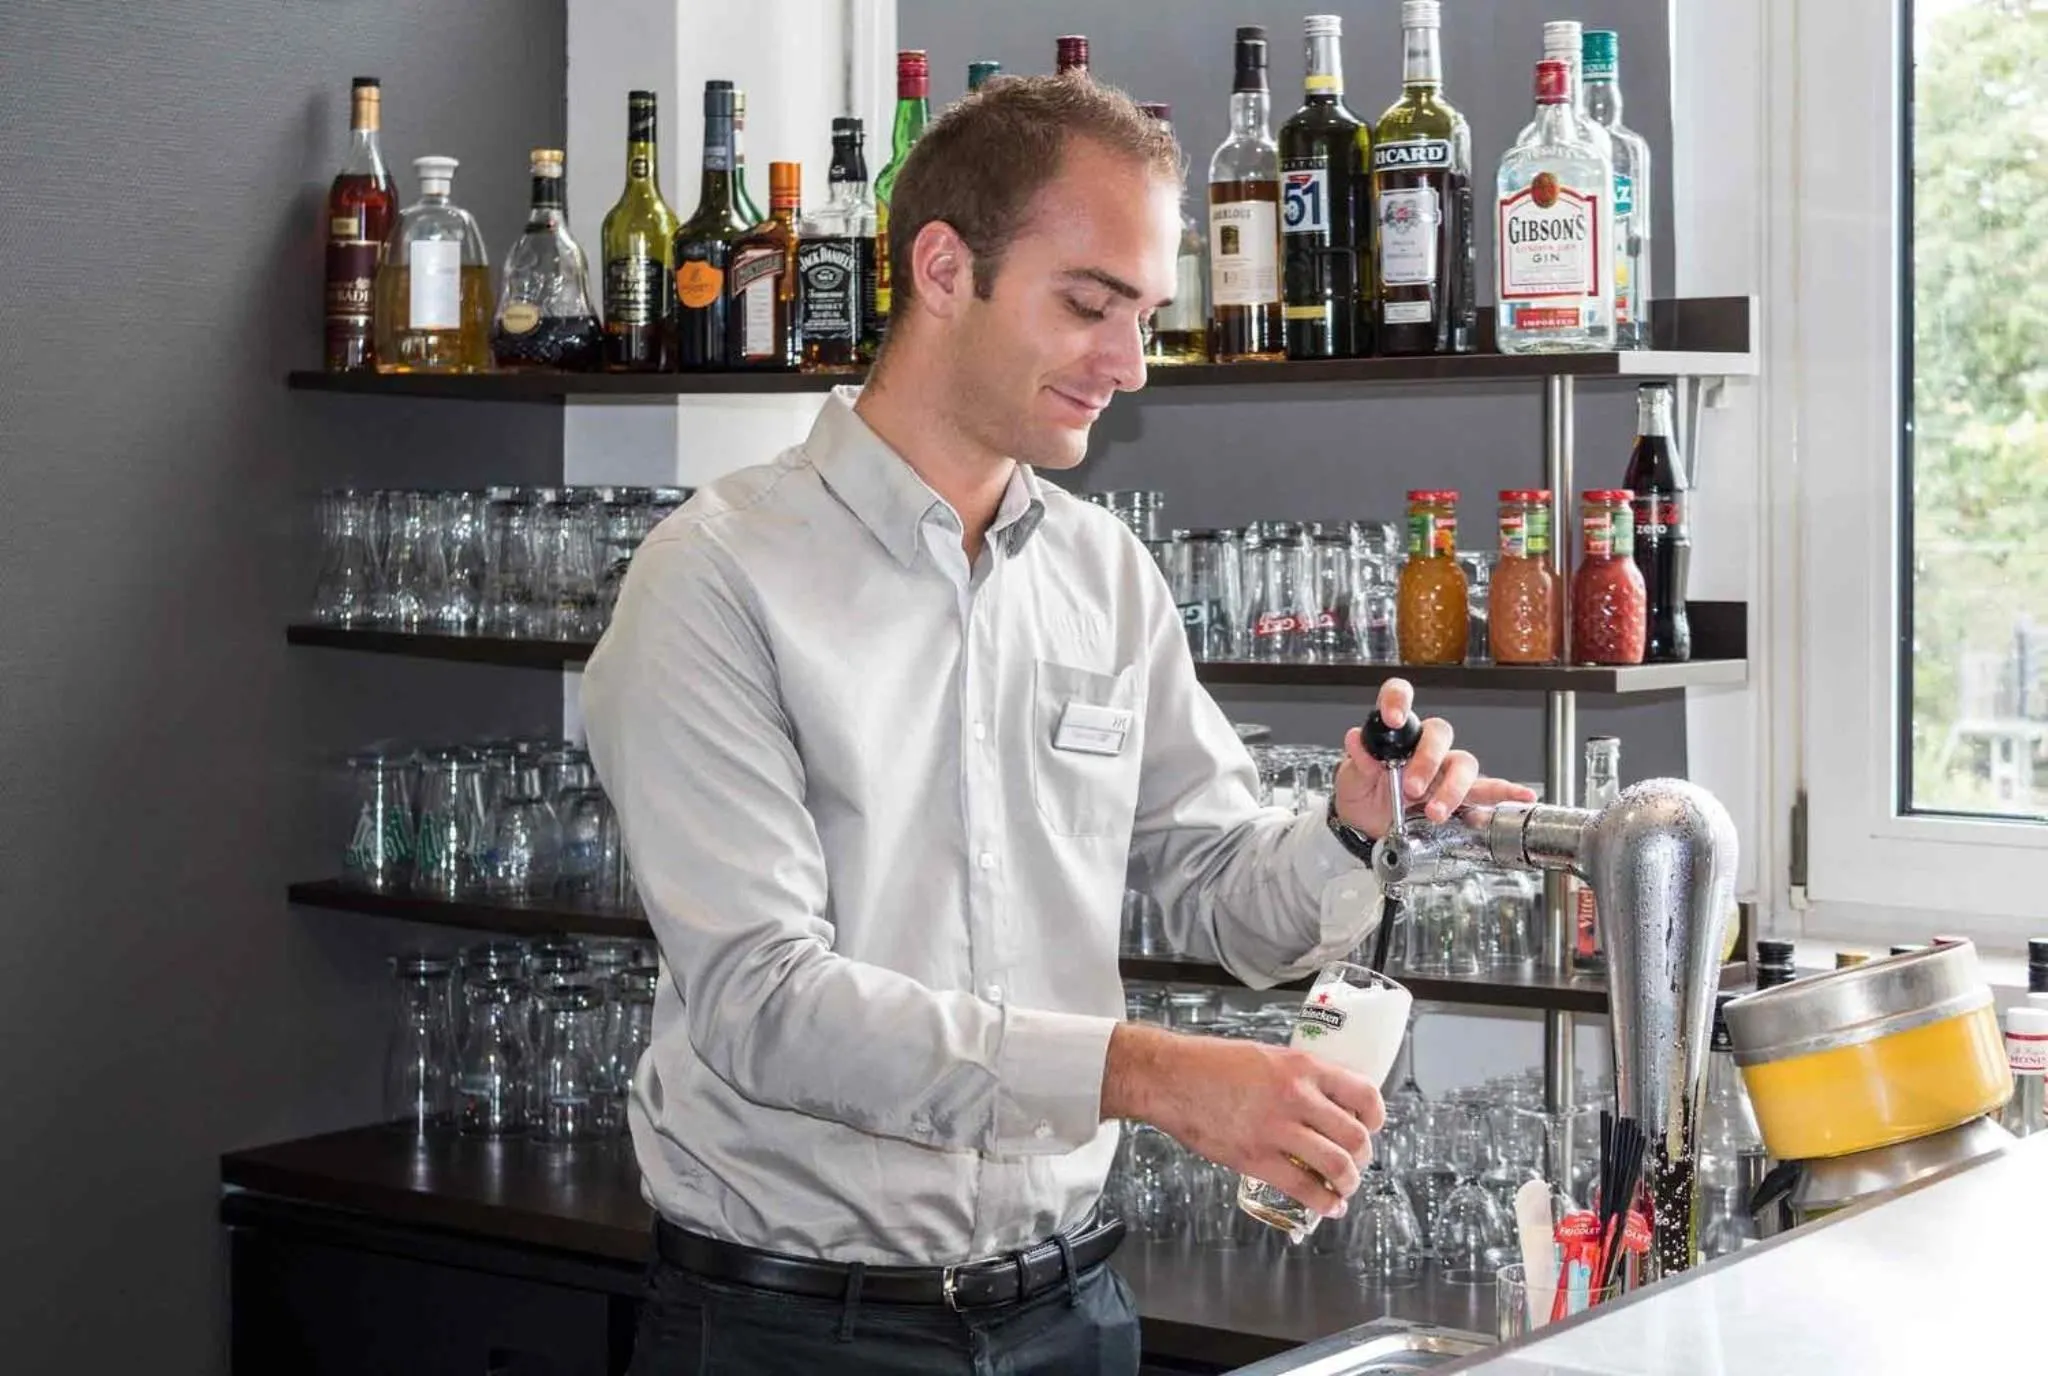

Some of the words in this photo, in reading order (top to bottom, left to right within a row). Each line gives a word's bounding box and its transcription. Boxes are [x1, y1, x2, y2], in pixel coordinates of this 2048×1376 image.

[1283, 181, 1321, 226] 51
[1509, 213, 1584, 245] GIBSON'S
[1532, 252, 1560, 263] GIN
[1636, 524, 1667, 535] zero
